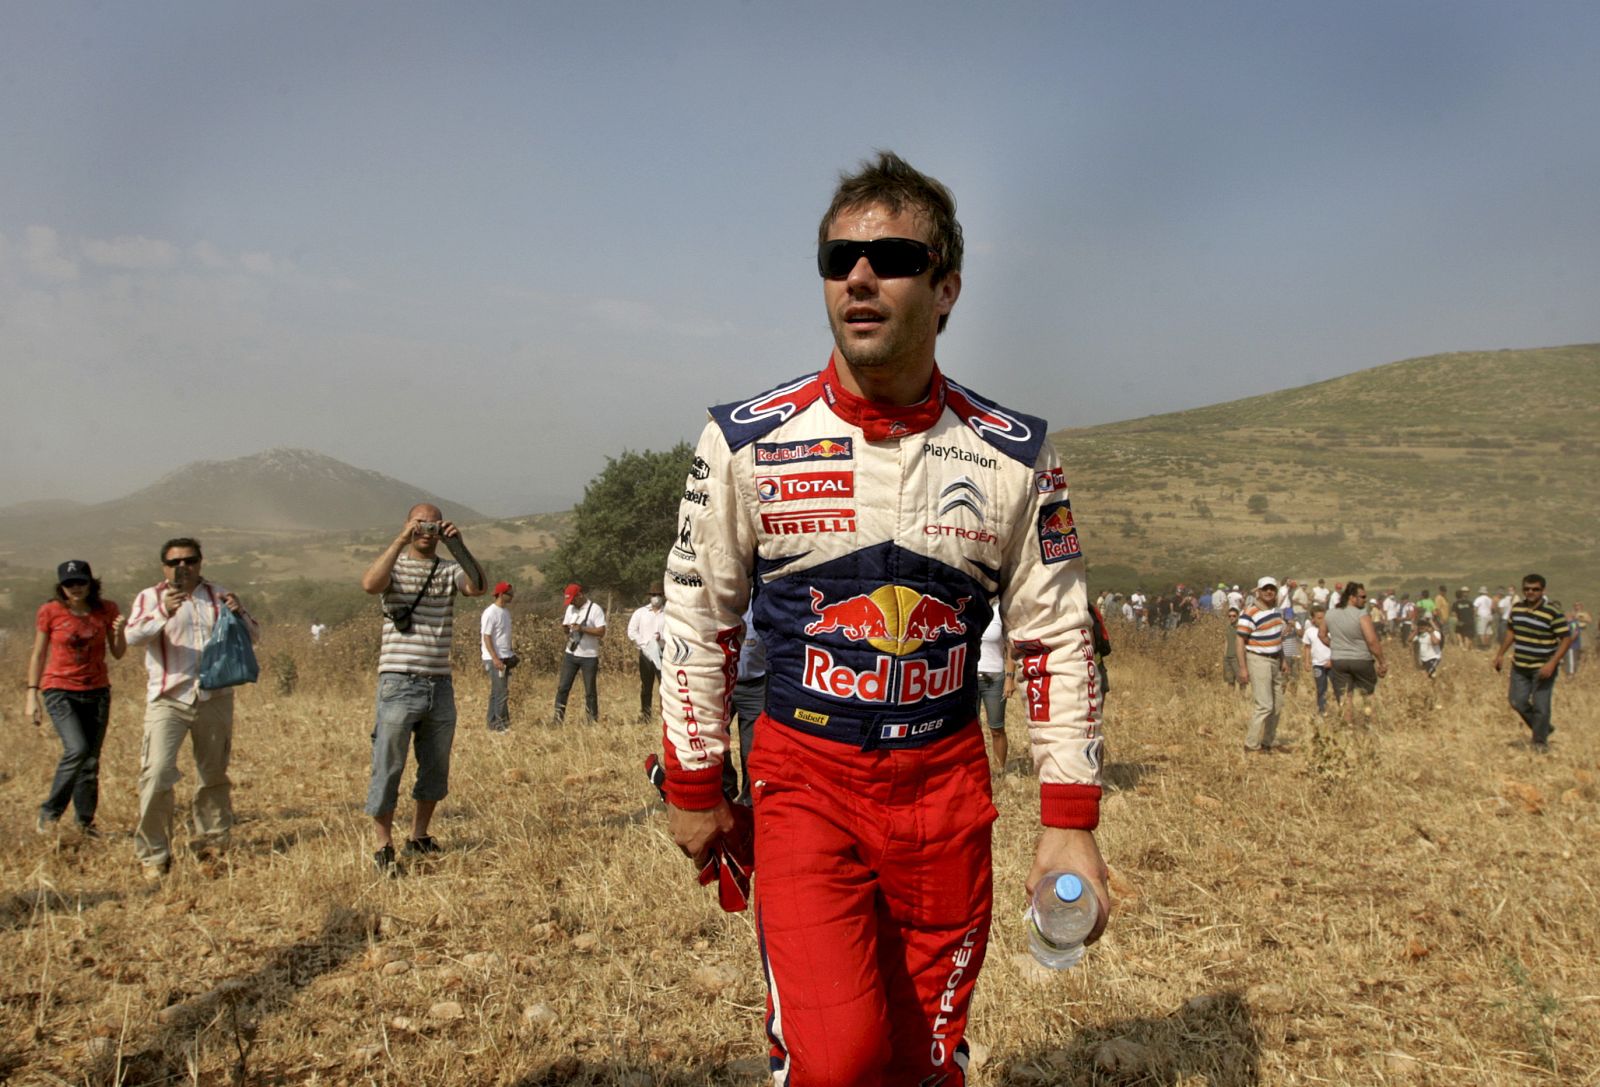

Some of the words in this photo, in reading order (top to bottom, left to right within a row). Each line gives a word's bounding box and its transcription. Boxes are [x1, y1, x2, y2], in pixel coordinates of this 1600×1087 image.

[757, 447, 781, 461] Red
[781, 444, 804, 460] Bull
[923, 443, 997, 469] PlayStation
[783, 479, 850, 494] TOTAL
[760, 508, 856, 535] PIRELLI
[1042, 536, 1067, 560] Red
[802, 644, 892, 703] Red
[898, 642, 967, 706] Bull
[1027, 655, 1043, 717] TOTAL
[911, 718, 944, 736] LOEB
